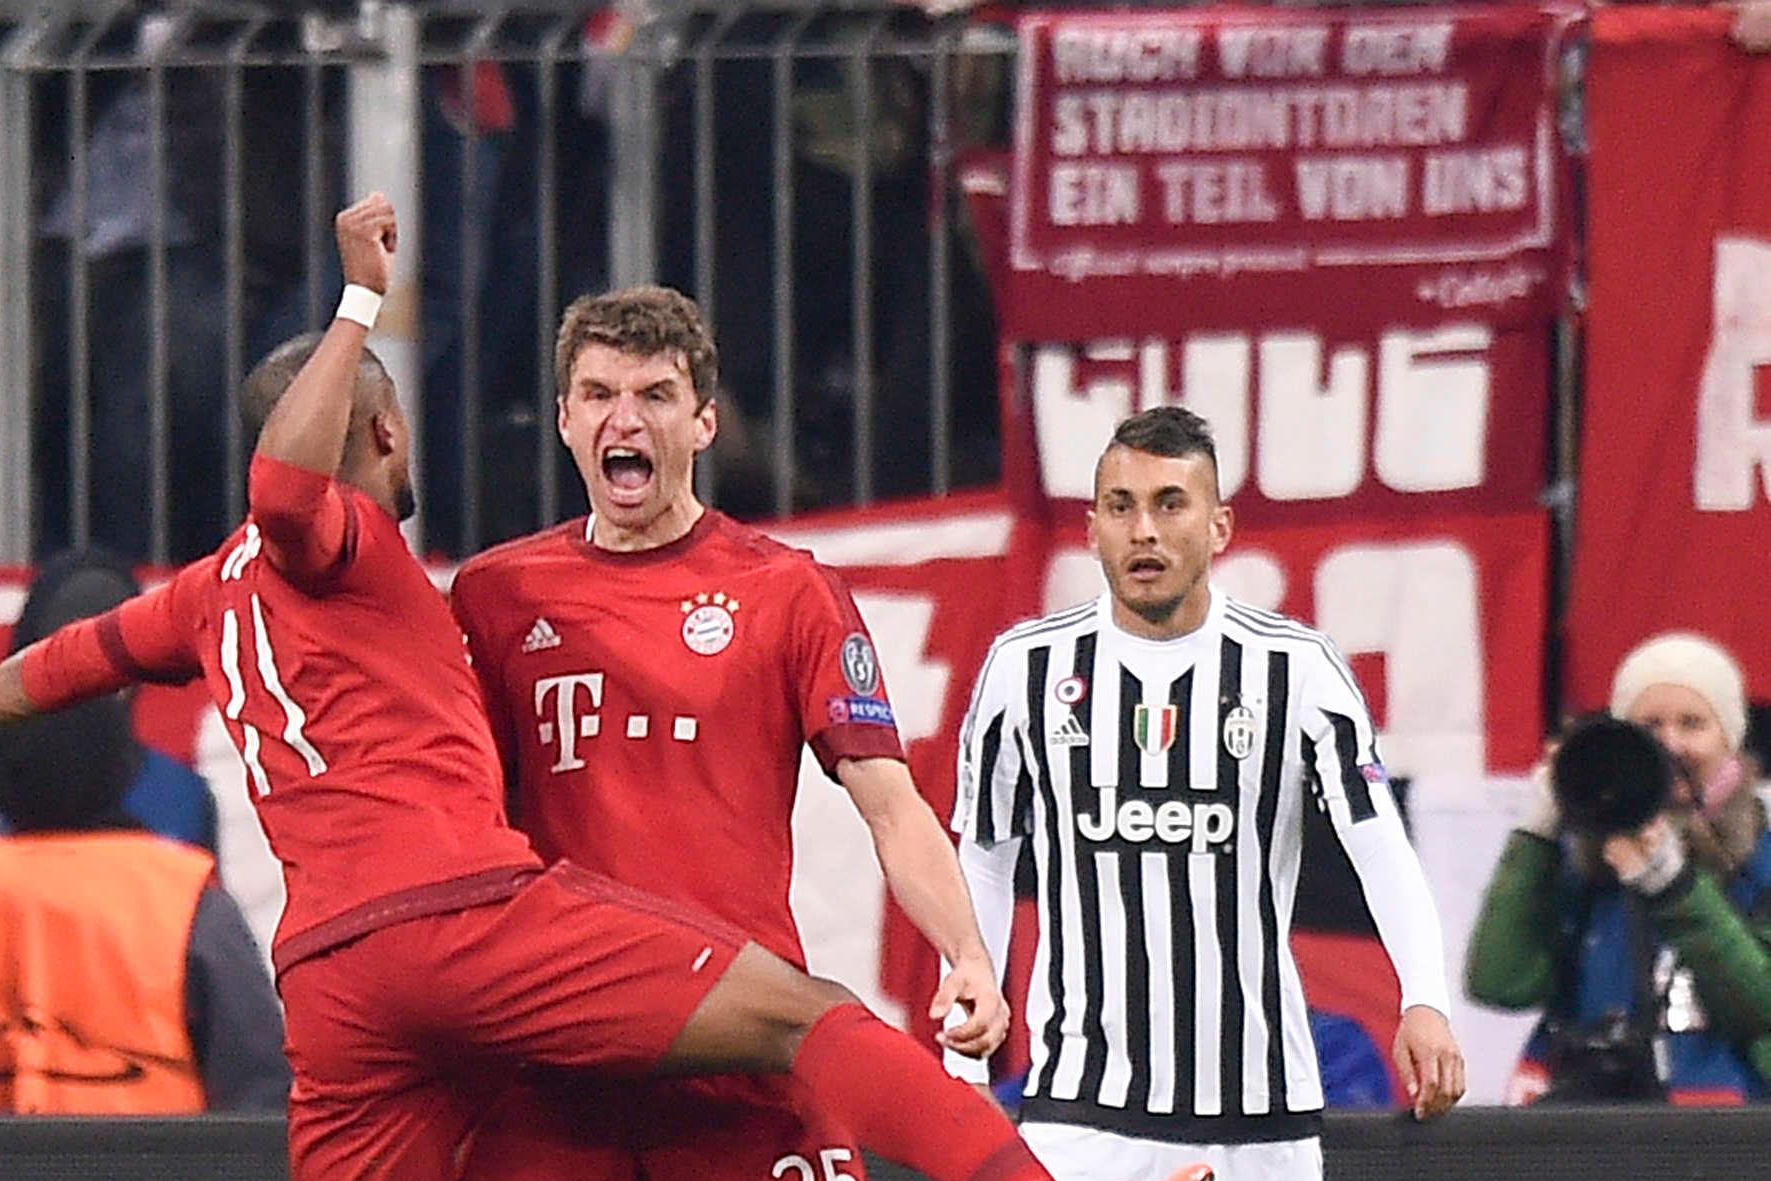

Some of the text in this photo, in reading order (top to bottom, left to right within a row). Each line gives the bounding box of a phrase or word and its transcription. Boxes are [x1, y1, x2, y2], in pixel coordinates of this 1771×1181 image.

[1049, 146, 1525, 226] EIN TEIL VON UNS
[1077, 786, 1234, 854] Jeep
